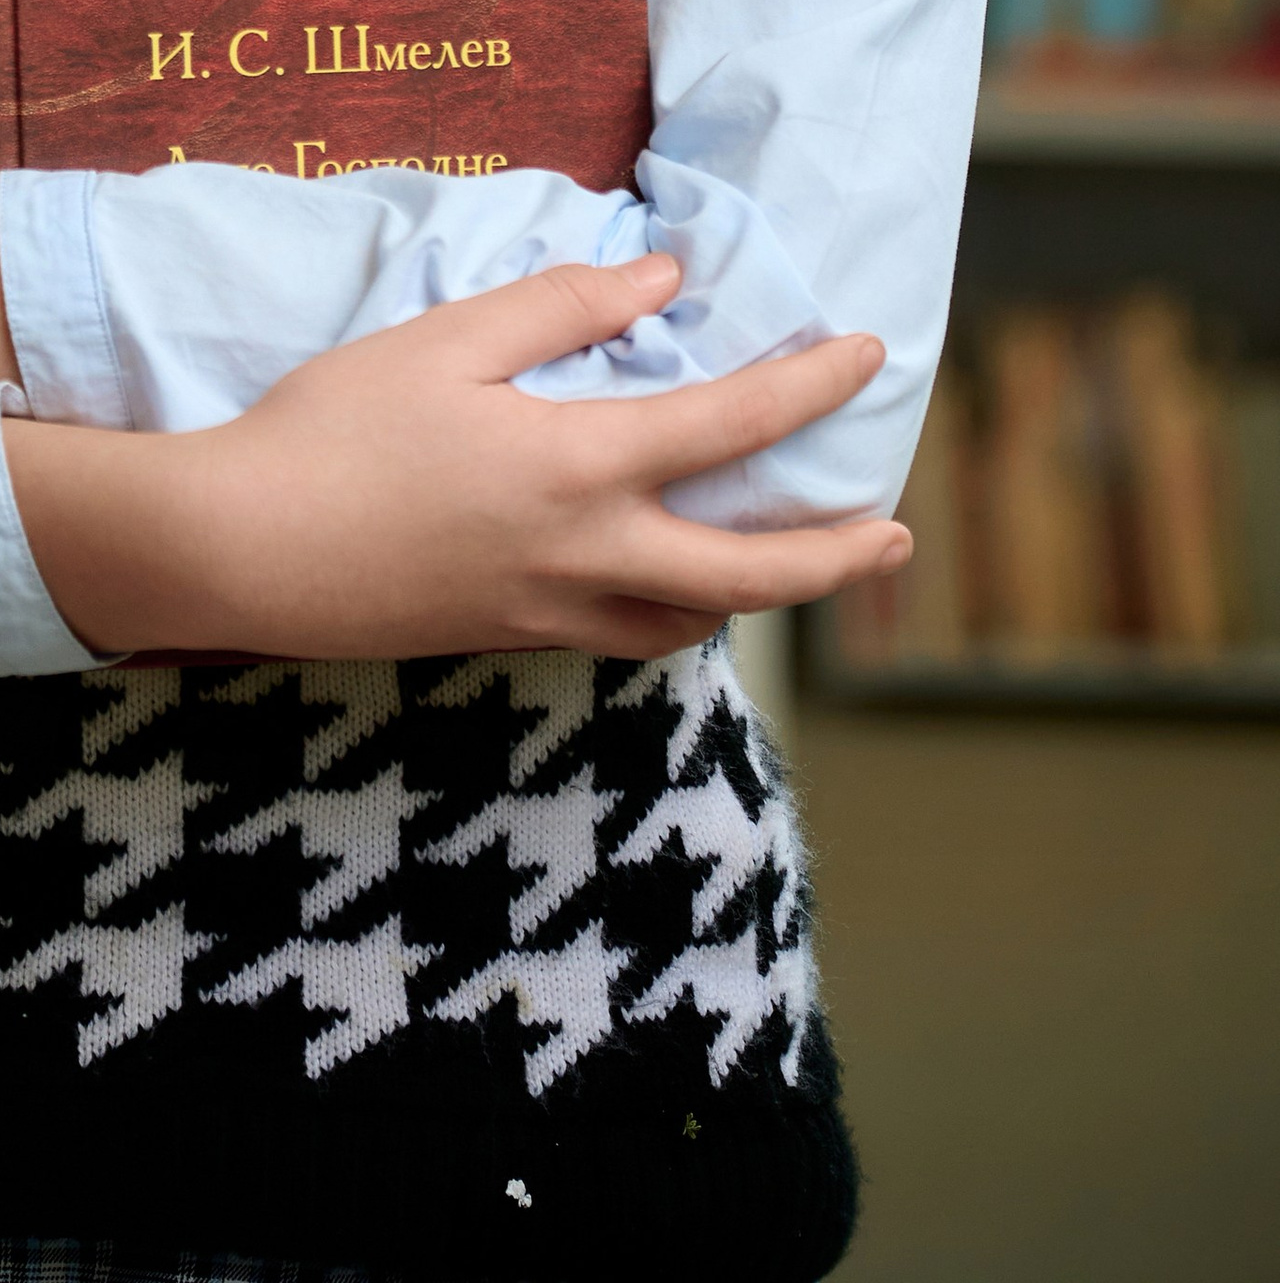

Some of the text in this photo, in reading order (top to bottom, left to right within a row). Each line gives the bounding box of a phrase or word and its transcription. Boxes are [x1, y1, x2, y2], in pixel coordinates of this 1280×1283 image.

[147, 24, 512, 81] И. С. Шмелев
